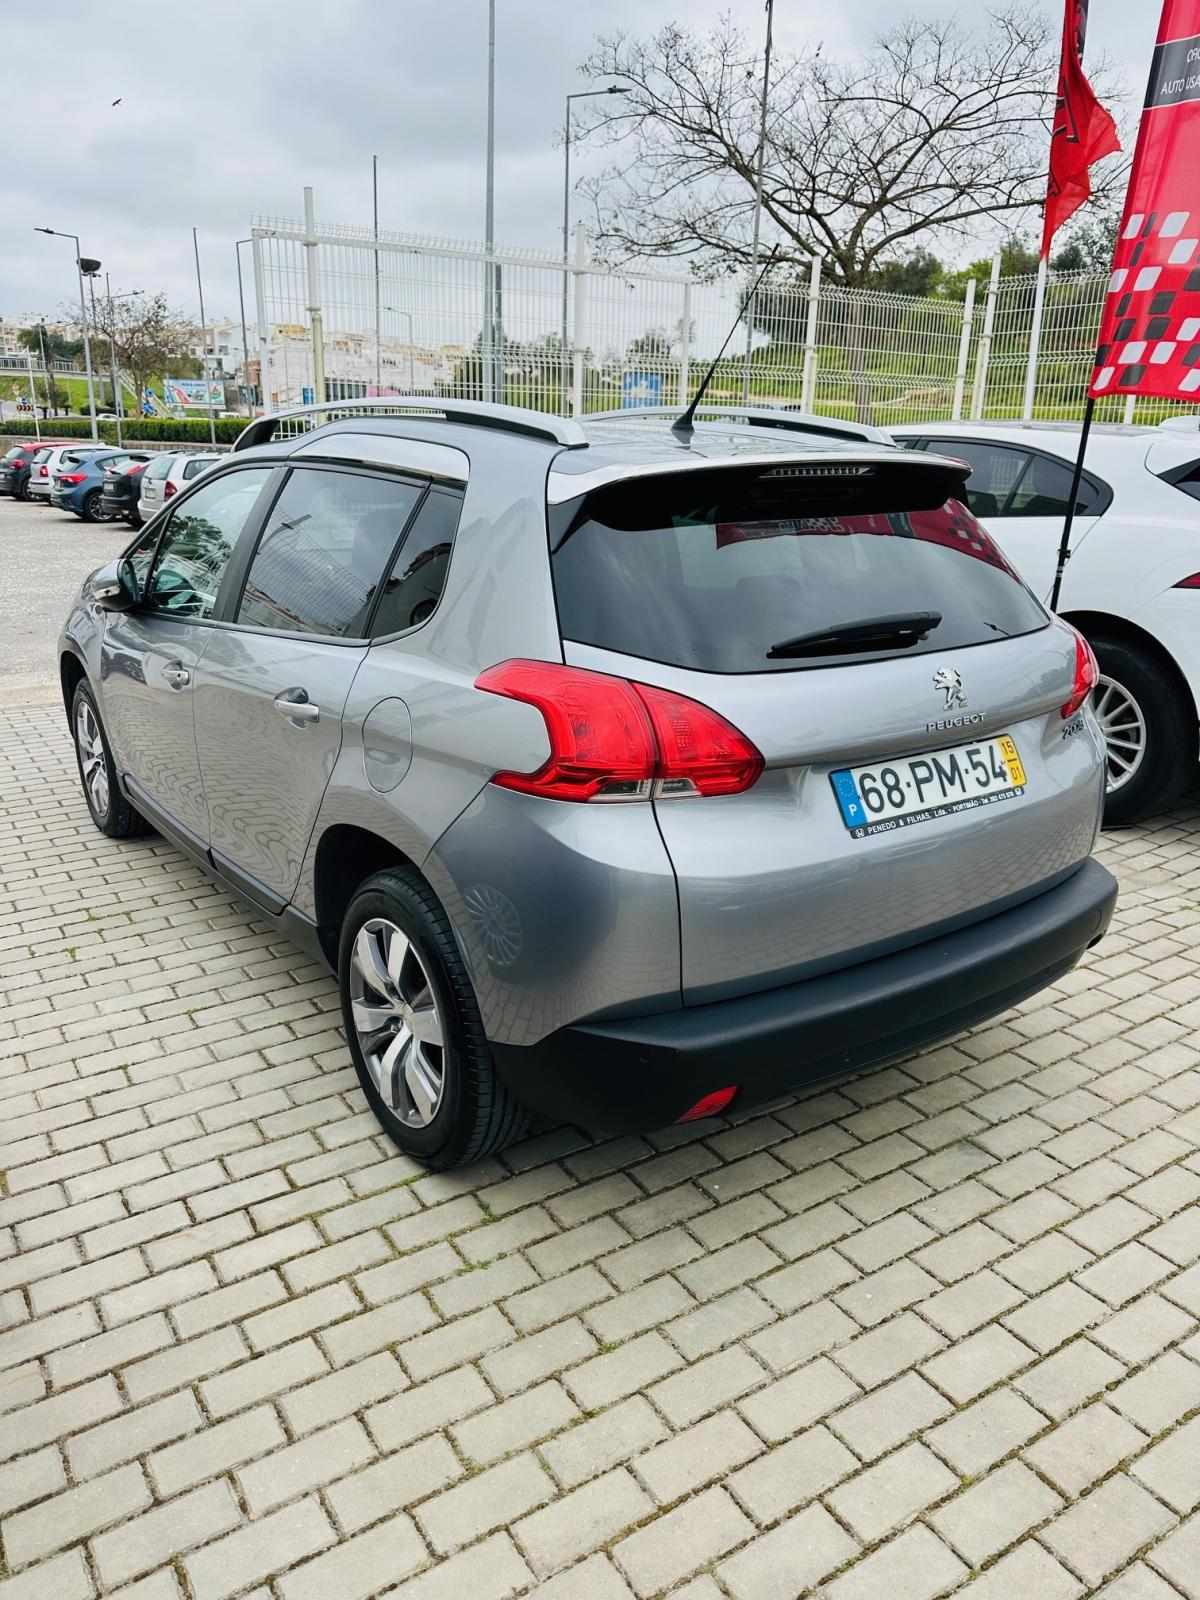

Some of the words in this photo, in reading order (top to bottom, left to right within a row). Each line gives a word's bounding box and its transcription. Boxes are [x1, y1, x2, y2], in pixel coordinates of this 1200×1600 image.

[1160, 78, 1185, 95] AUTO
[926, 712, 985, 733] PEUGEOT
[1002, 740, 1014, 755] 15
[1011, 767, 1021, 781] 01
[848, 804, 857, 817] P
[867, 820, 896, 834] PENEDO
